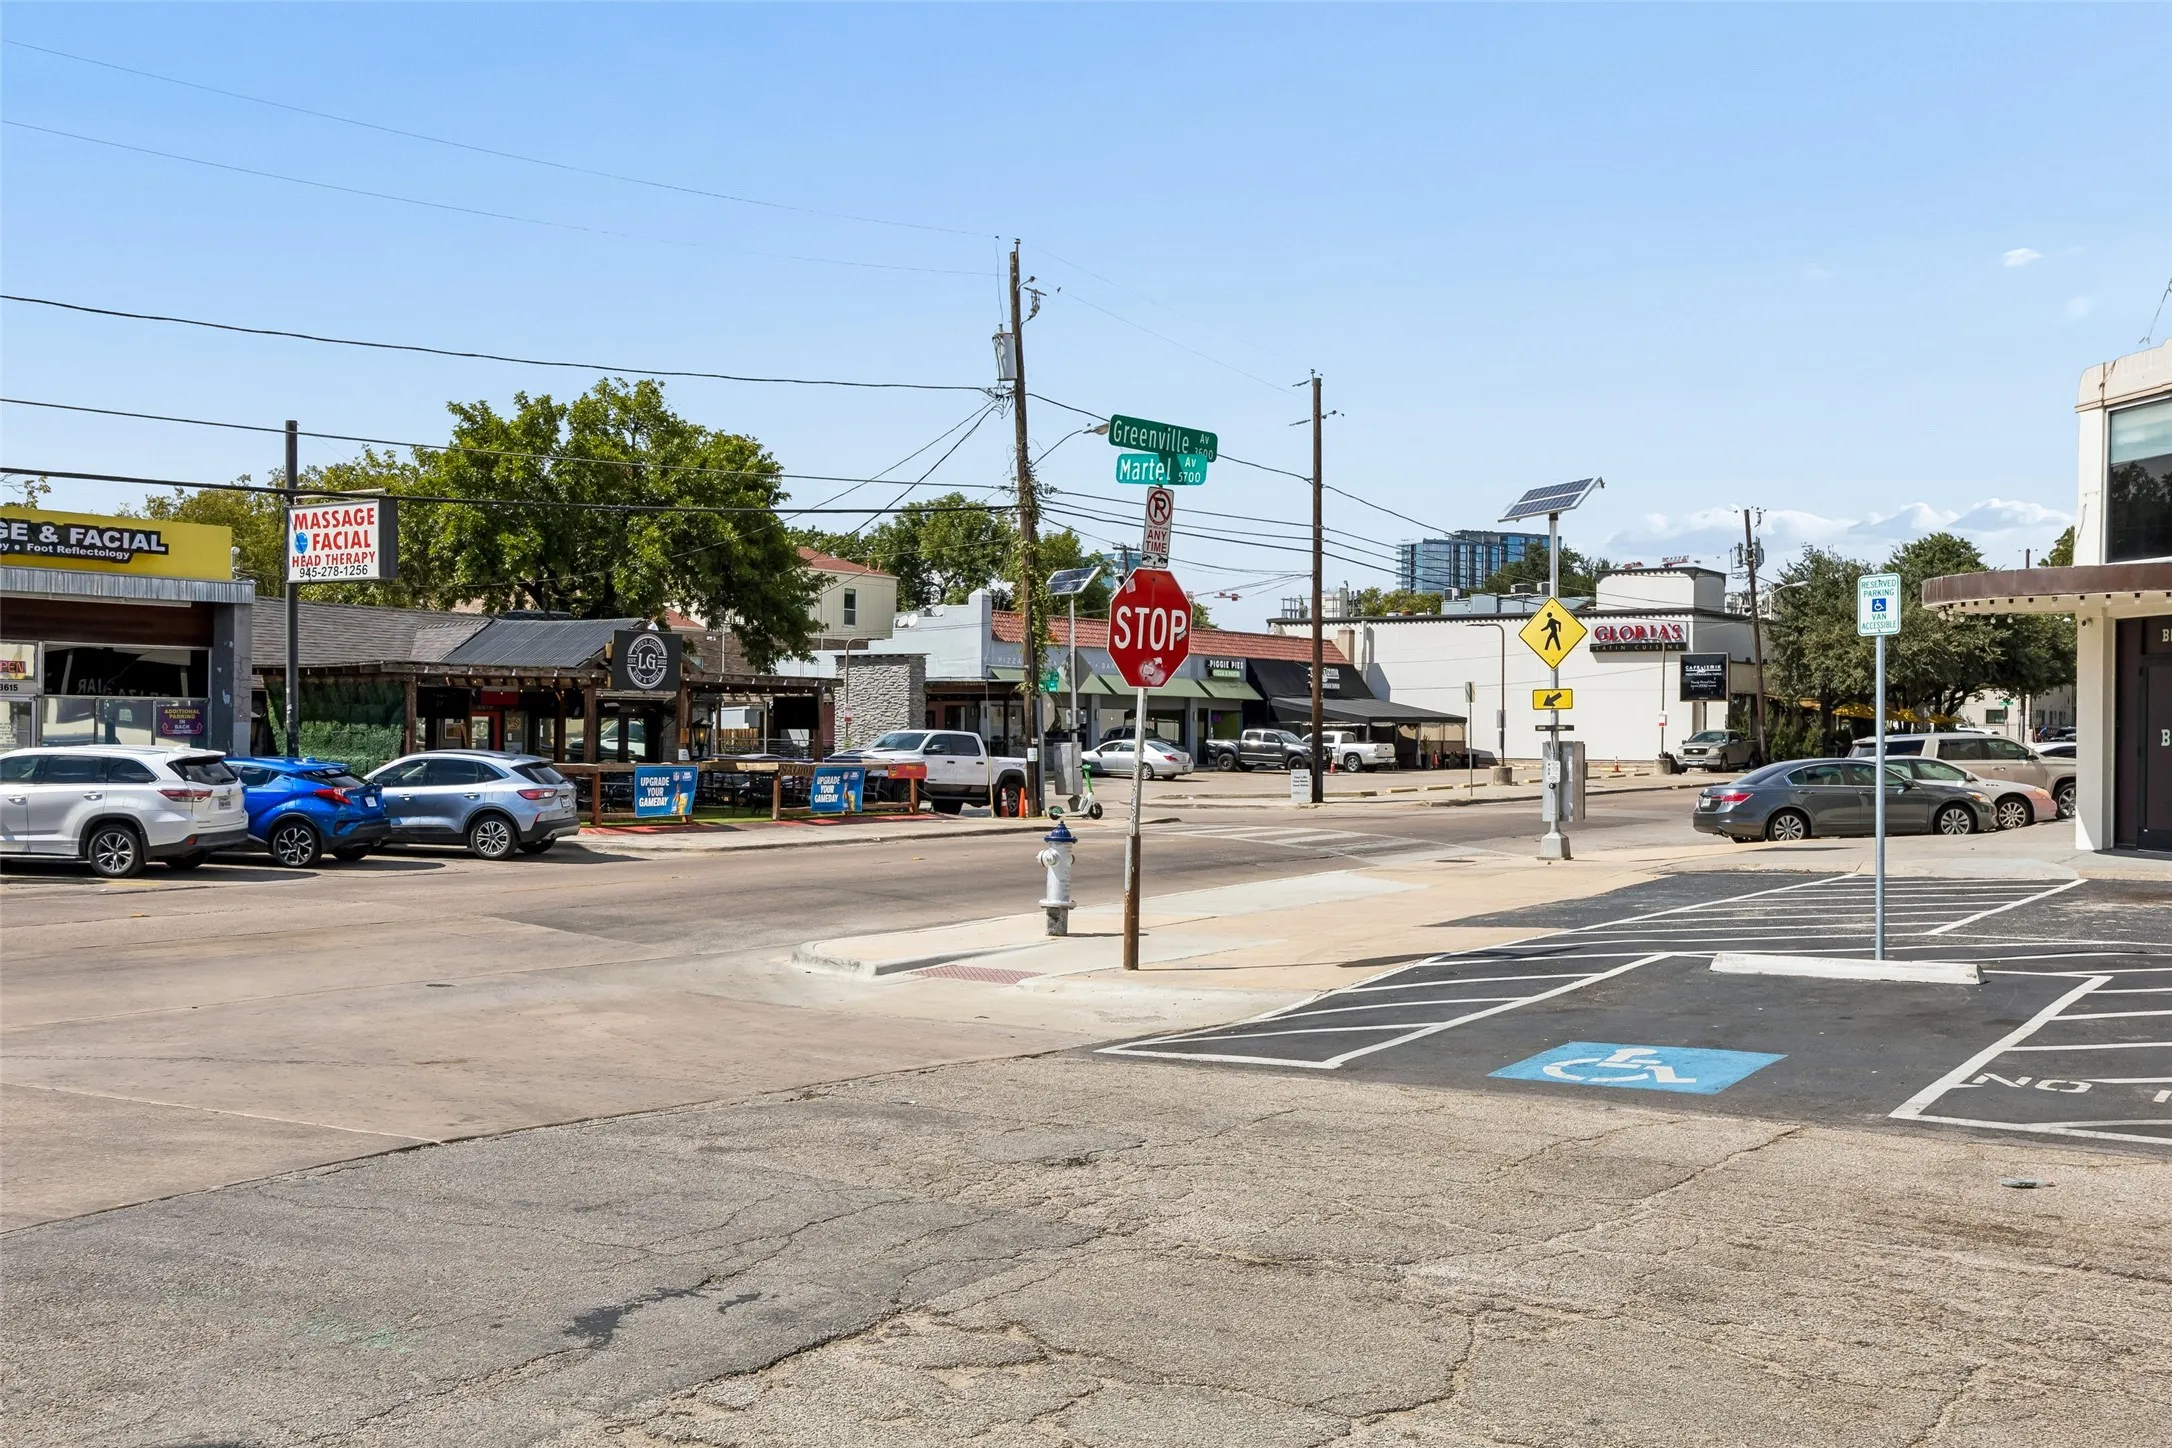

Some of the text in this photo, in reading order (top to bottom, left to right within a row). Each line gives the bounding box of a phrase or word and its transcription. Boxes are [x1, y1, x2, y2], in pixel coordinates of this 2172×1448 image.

[1113, 419, 1210, 453] Greenville Av
[1119, 456, 1197, 481] Martel Av
[1178, 471, 1201, 483] 5700
[294, 507, 375, 530] MASSAGE
[39, 525, 59, 543] &
[69, 527, 165, 551] FACIAL
[312, 530, 371, 551] FACIAL
[1147, 529, 1167, 541] ANY
[27, 543, 53, 553] Foot
[57, 545, 130, 560] Reflectology
[1145, 540, 1167, 553] TIME
[292, 551, 376, 568] HEAD THERAPY
[299, 565, 368, 578] 945-278-1256
[1861, 579, 1897, 589] RESERVED
[1863, 588, 1895, 598] PARKING
[1114, 605, 1187, 651] STOP
[1861, 620, 1897, 630] ACCESSIBLE
[1594, 623, 1682, 641] GLORIA'S
[638, 653, 656, 669] LG
[998, 656, 1022, 664] PIZZA
[1209, 659, 1244, 669] PIGGIE PIES
[640, 776, 670, 786] UPGRADE
[817, 776, 840, 785] UPGRADE
[647, 787, 664, 796] YOUR
[820, 785, 835, 793] YOUR
[638, 797, 669, 807] GAMEDAY
[814, 794, 839, 803] GAMEDAY
[1972, 1073, 2093, 1093] NO
